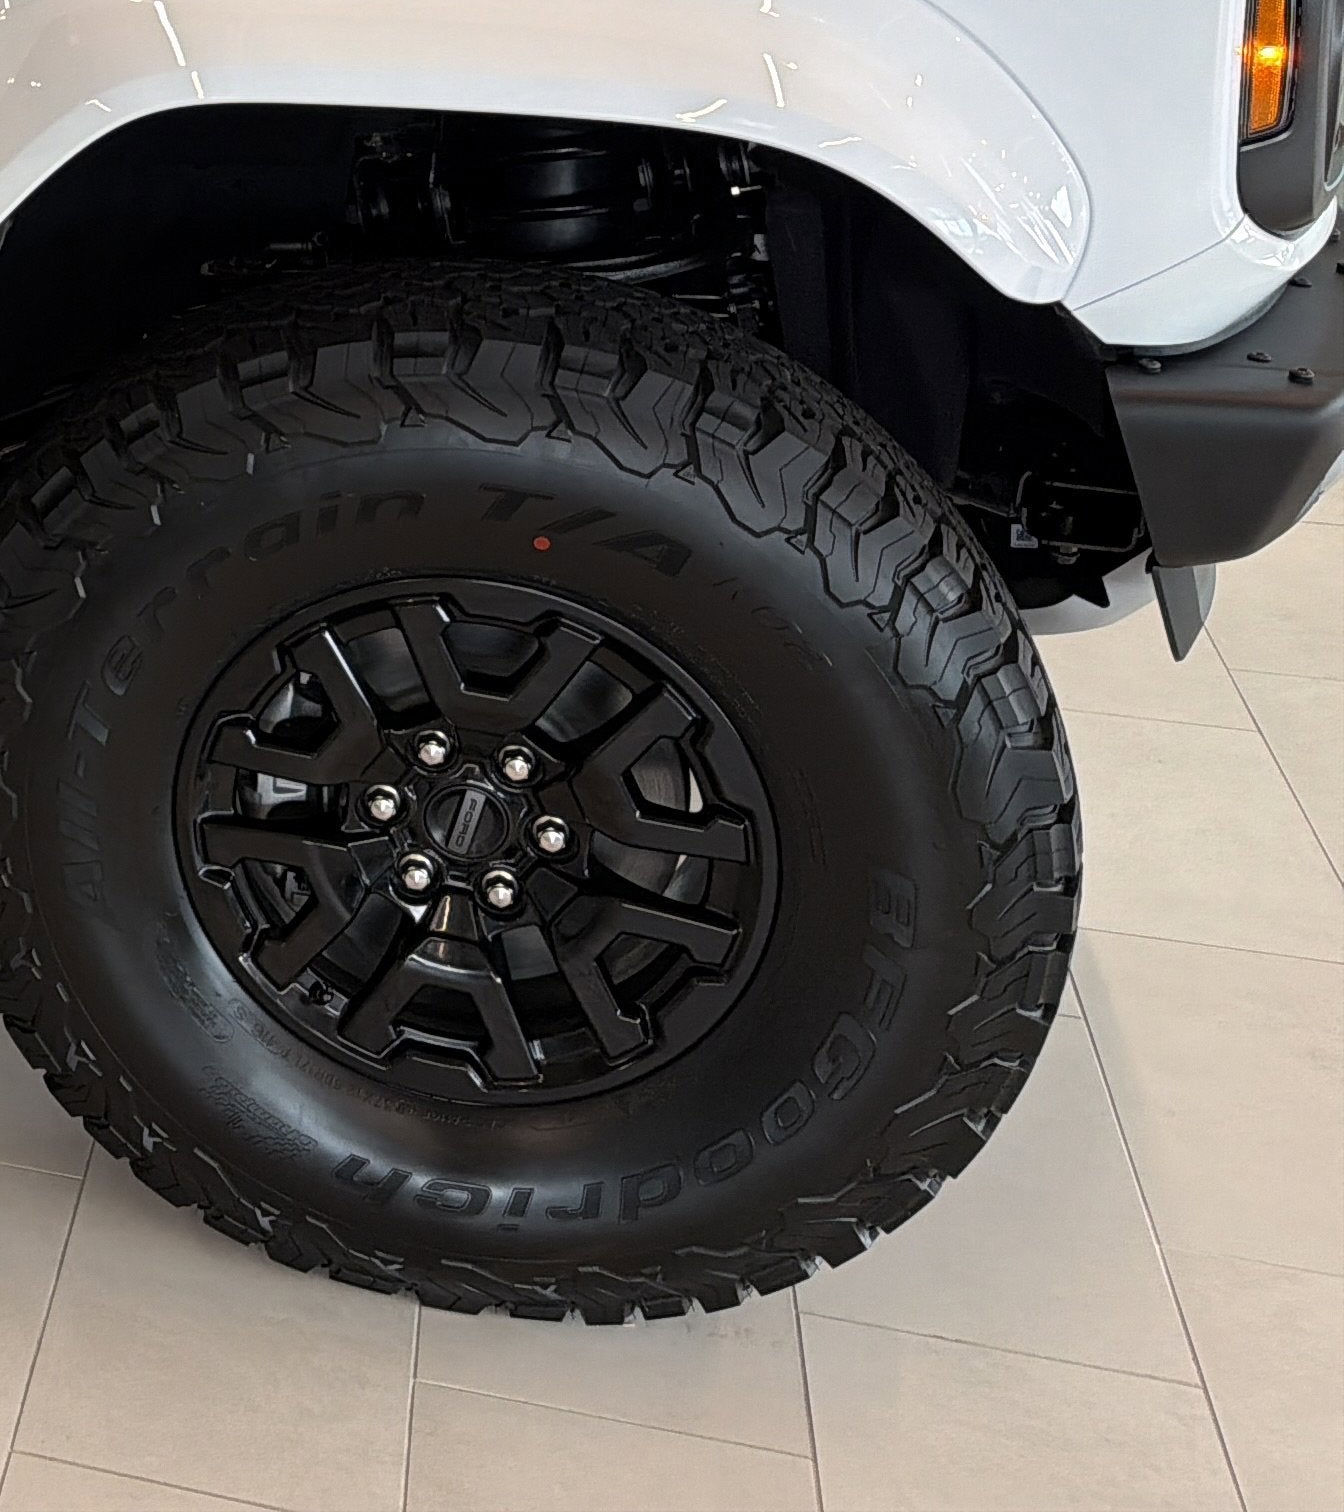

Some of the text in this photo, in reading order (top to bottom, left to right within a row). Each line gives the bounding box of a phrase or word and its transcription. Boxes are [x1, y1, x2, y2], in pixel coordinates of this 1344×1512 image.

[57, 489, 427, 906] All-Terrain
[478, 482, 694, 578] T/A
[454, 798, 478, 848] FORD
[333, 875, 916, 1234] BFGoodrich
